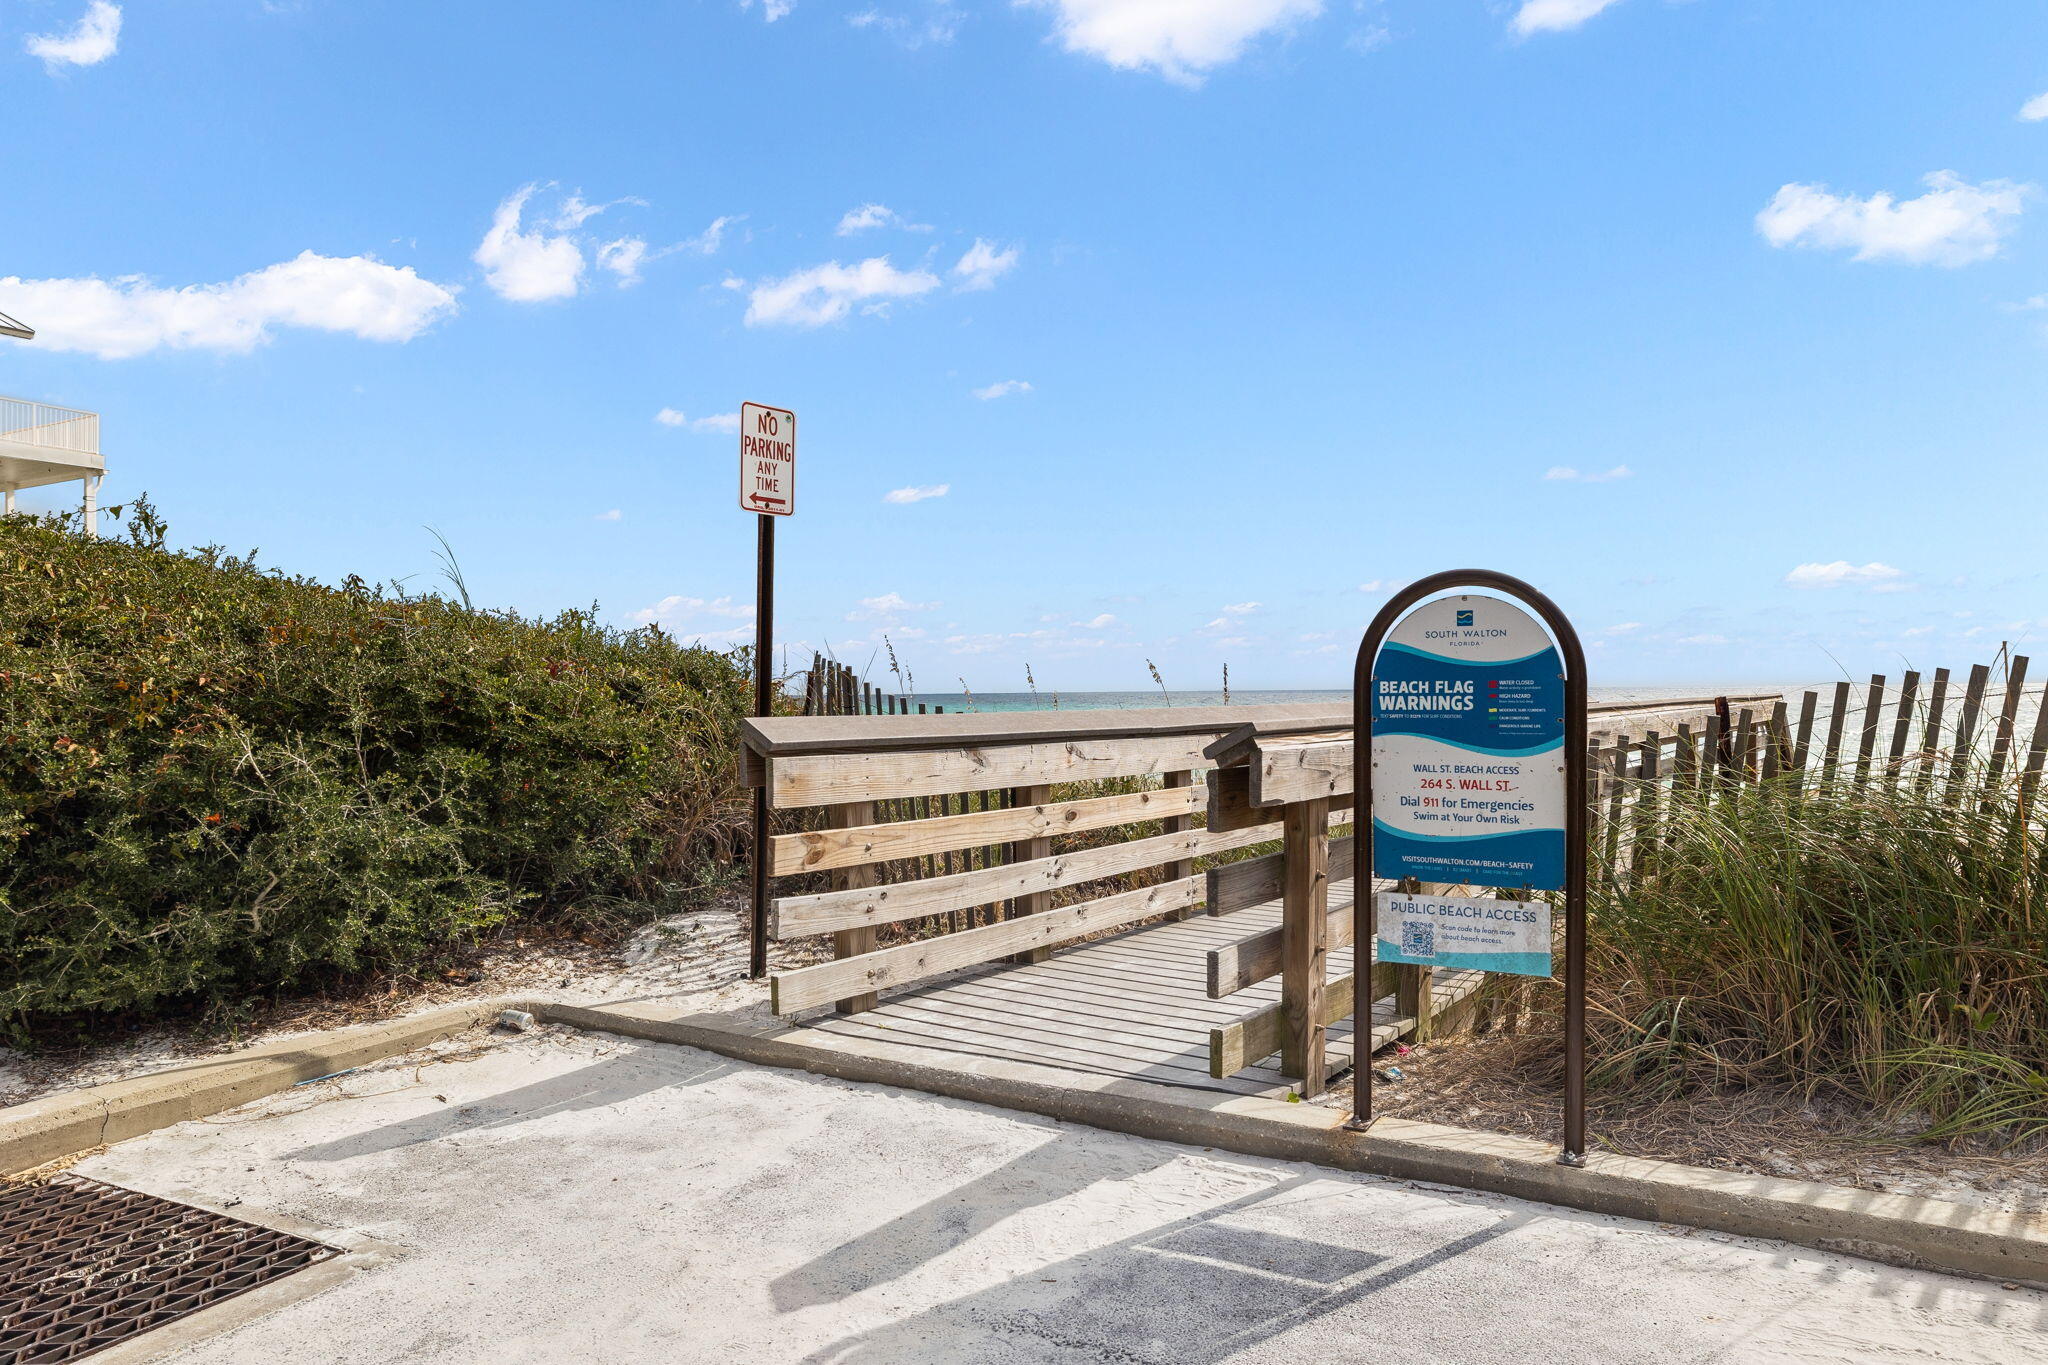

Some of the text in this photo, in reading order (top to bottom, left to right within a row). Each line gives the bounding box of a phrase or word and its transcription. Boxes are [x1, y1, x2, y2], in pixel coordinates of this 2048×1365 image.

[758, 414, 778, 436] NO
[744, 434, 791, 462] PARKING
[758, 460, 778, 476] ANY
[756, 476, 779, 492] TIME
[1425, 630, 1458, 638] SOUTH
[1380, 680, 1474, 694] BEACH FLAG
[1379, 696, 1474, 710] WARNINGS
[1414, 764, 1520, 775] WALL ST. BEACH ACCESS
[1420, 779, 1512, 791] 264 S. WALL ST.
[1400, 796, 1534, 812] Dial 911 for Emergencies
[1414, 811, 1520, 824] Swim at Your Own Risk
[1402, 856, 1534, 869] VISITSOUTHWALTON.COM/BEACH-SAFETY
[1391, 902, 1536, 922] PUBLIC BEACH ACCESS
